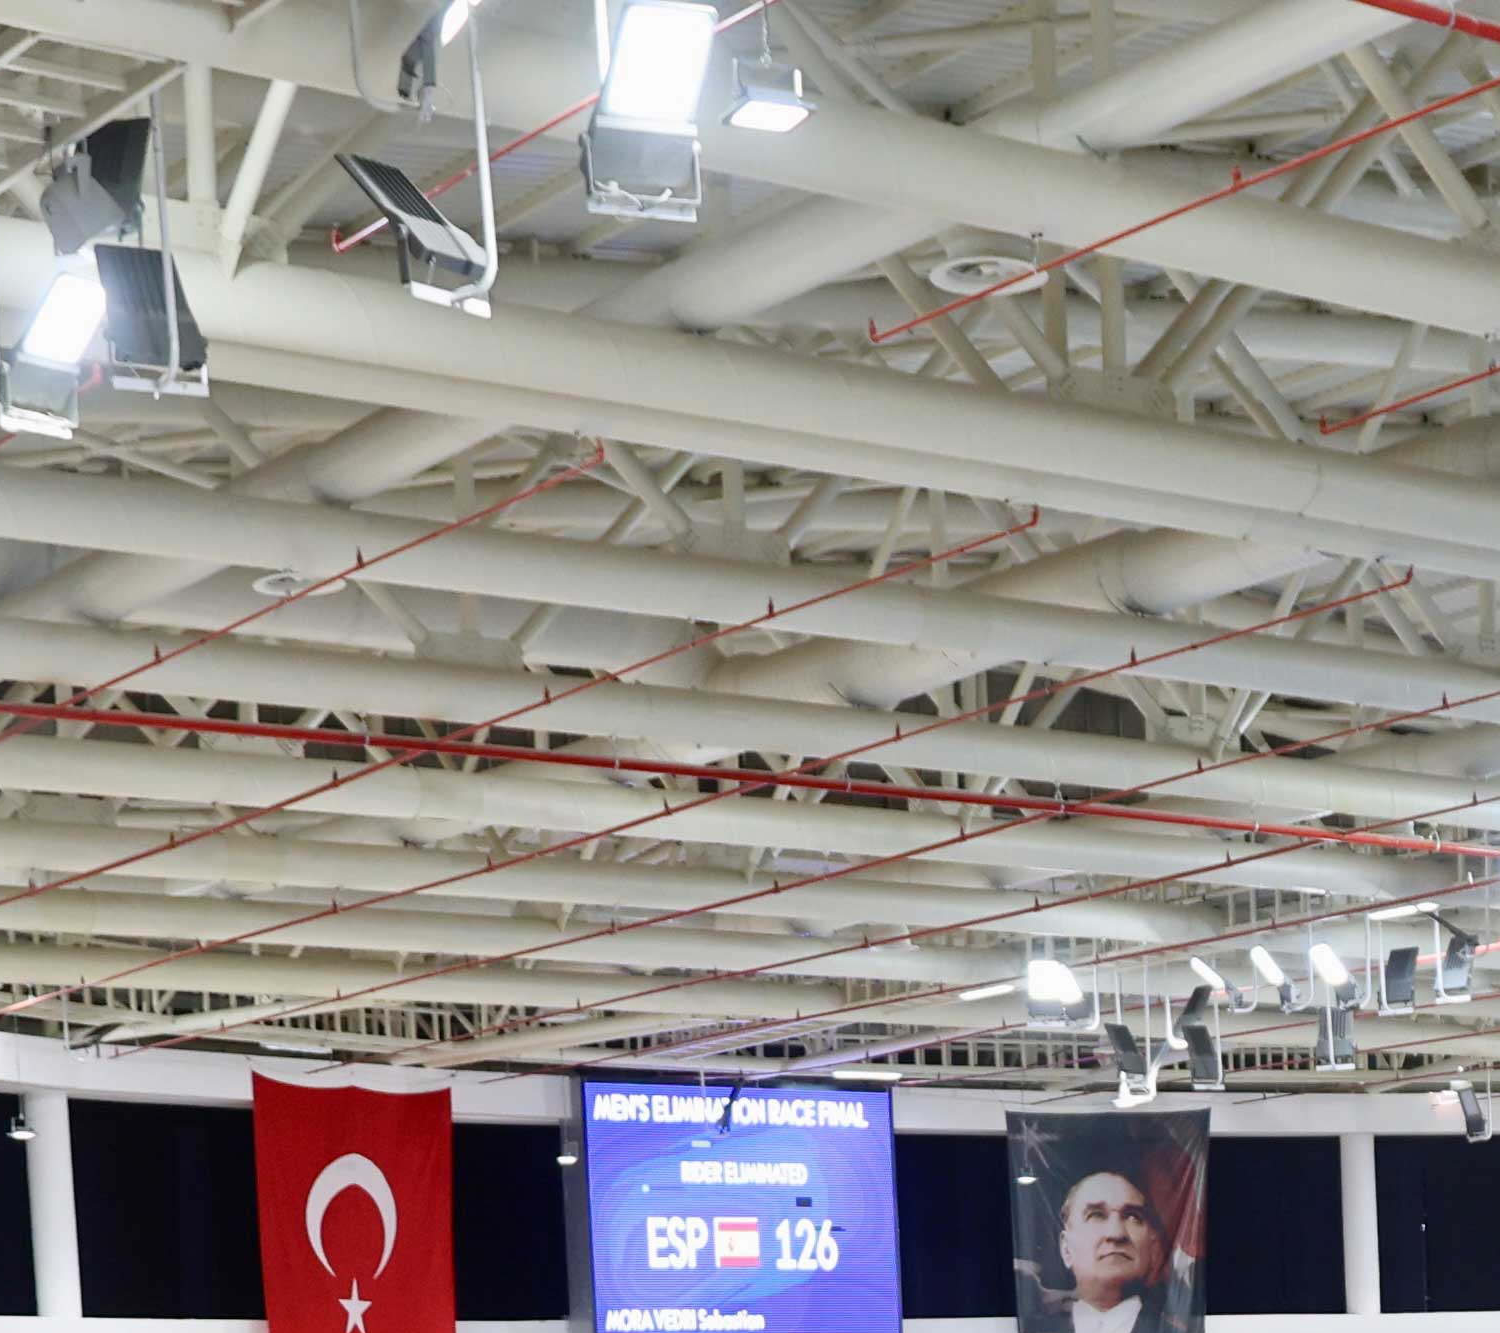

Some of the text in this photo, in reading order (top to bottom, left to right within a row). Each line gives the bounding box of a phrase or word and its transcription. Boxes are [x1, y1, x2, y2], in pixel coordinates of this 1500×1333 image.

[768, 1098, 817, 1127] RACE
[818, 1100, 869, 1128] FINAL
[680, 1161, 808, 1186] RIDER ELIMINATED
[646, 1216, 839, 1271] ESP 126
